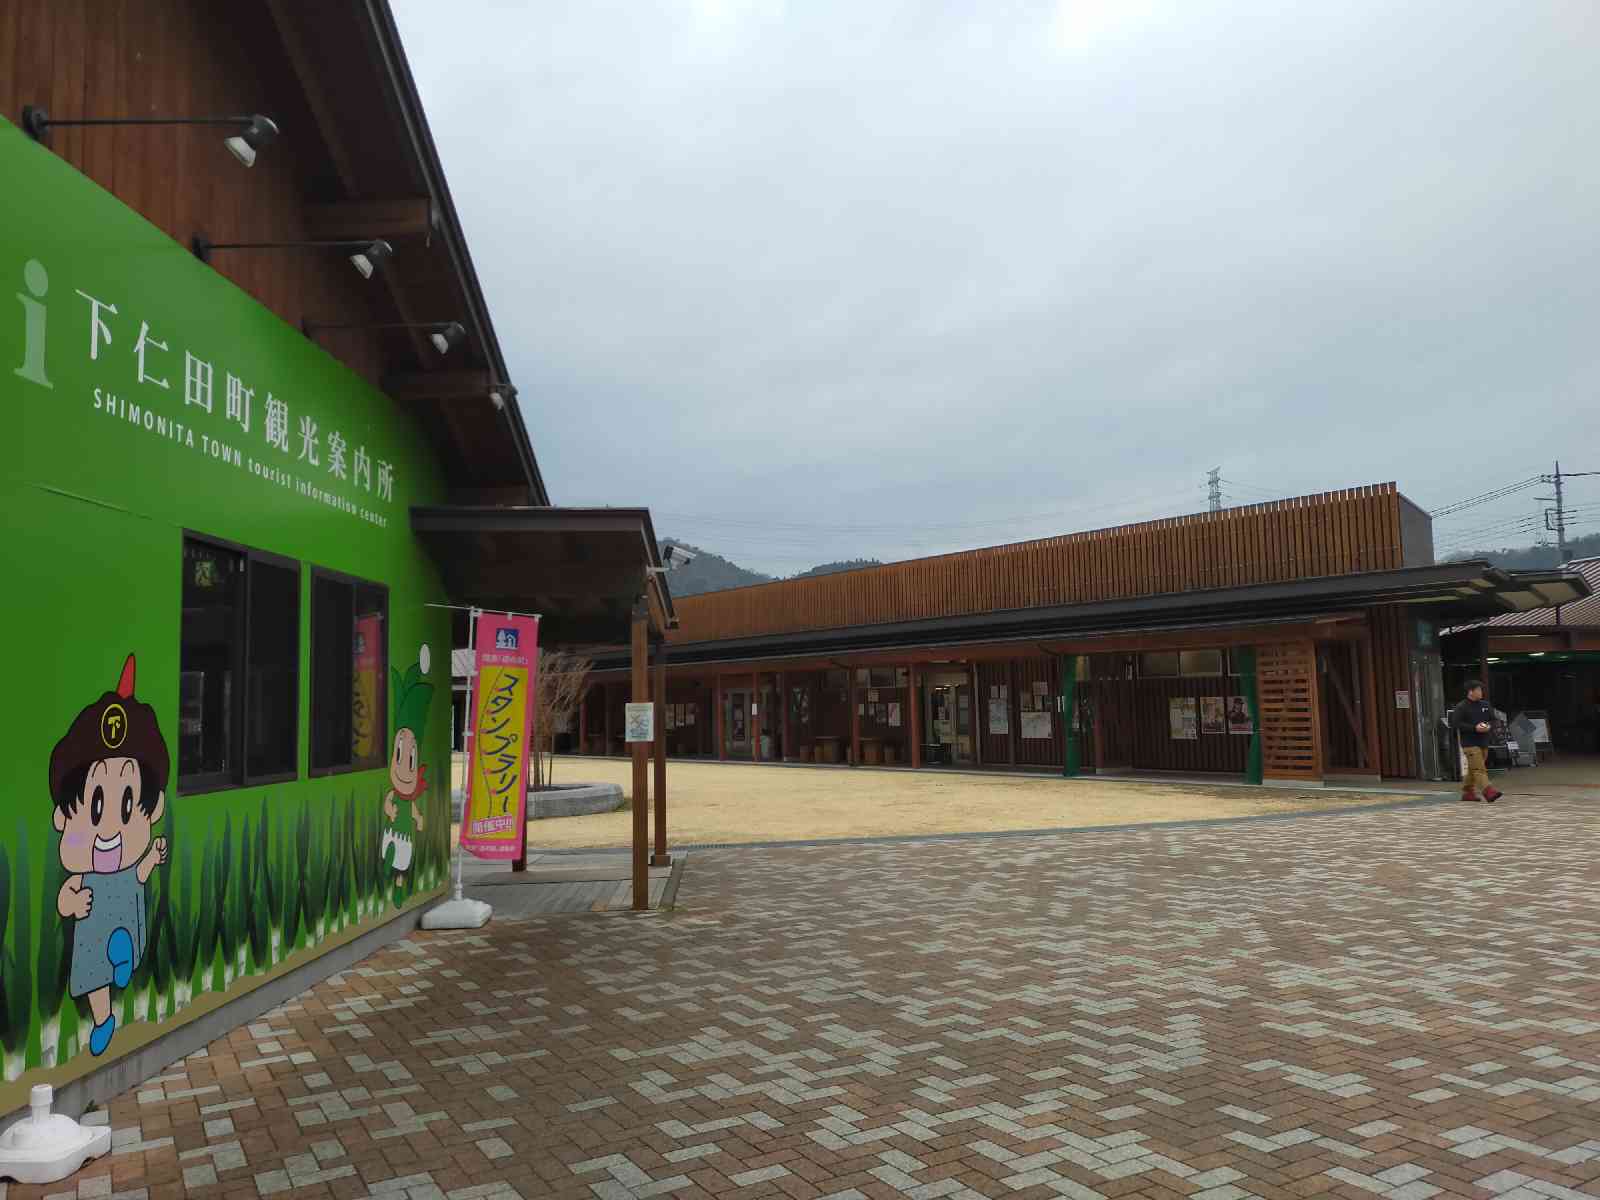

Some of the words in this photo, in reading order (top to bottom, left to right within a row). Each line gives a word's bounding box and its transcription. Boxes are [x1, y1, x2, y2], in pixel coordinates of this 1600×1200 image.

[75, 288, 394, 503] 下仁田町観光案内所
[94, 387, 194, 449] SHIMONITA
[201, 434, 242, 467] TOWN
[248, 457, 292, 489] tourist
[295, 476, 357, 516] information
[359, 507, 388, 529] center
[482, 673, 519, 813] スタンプラリー
